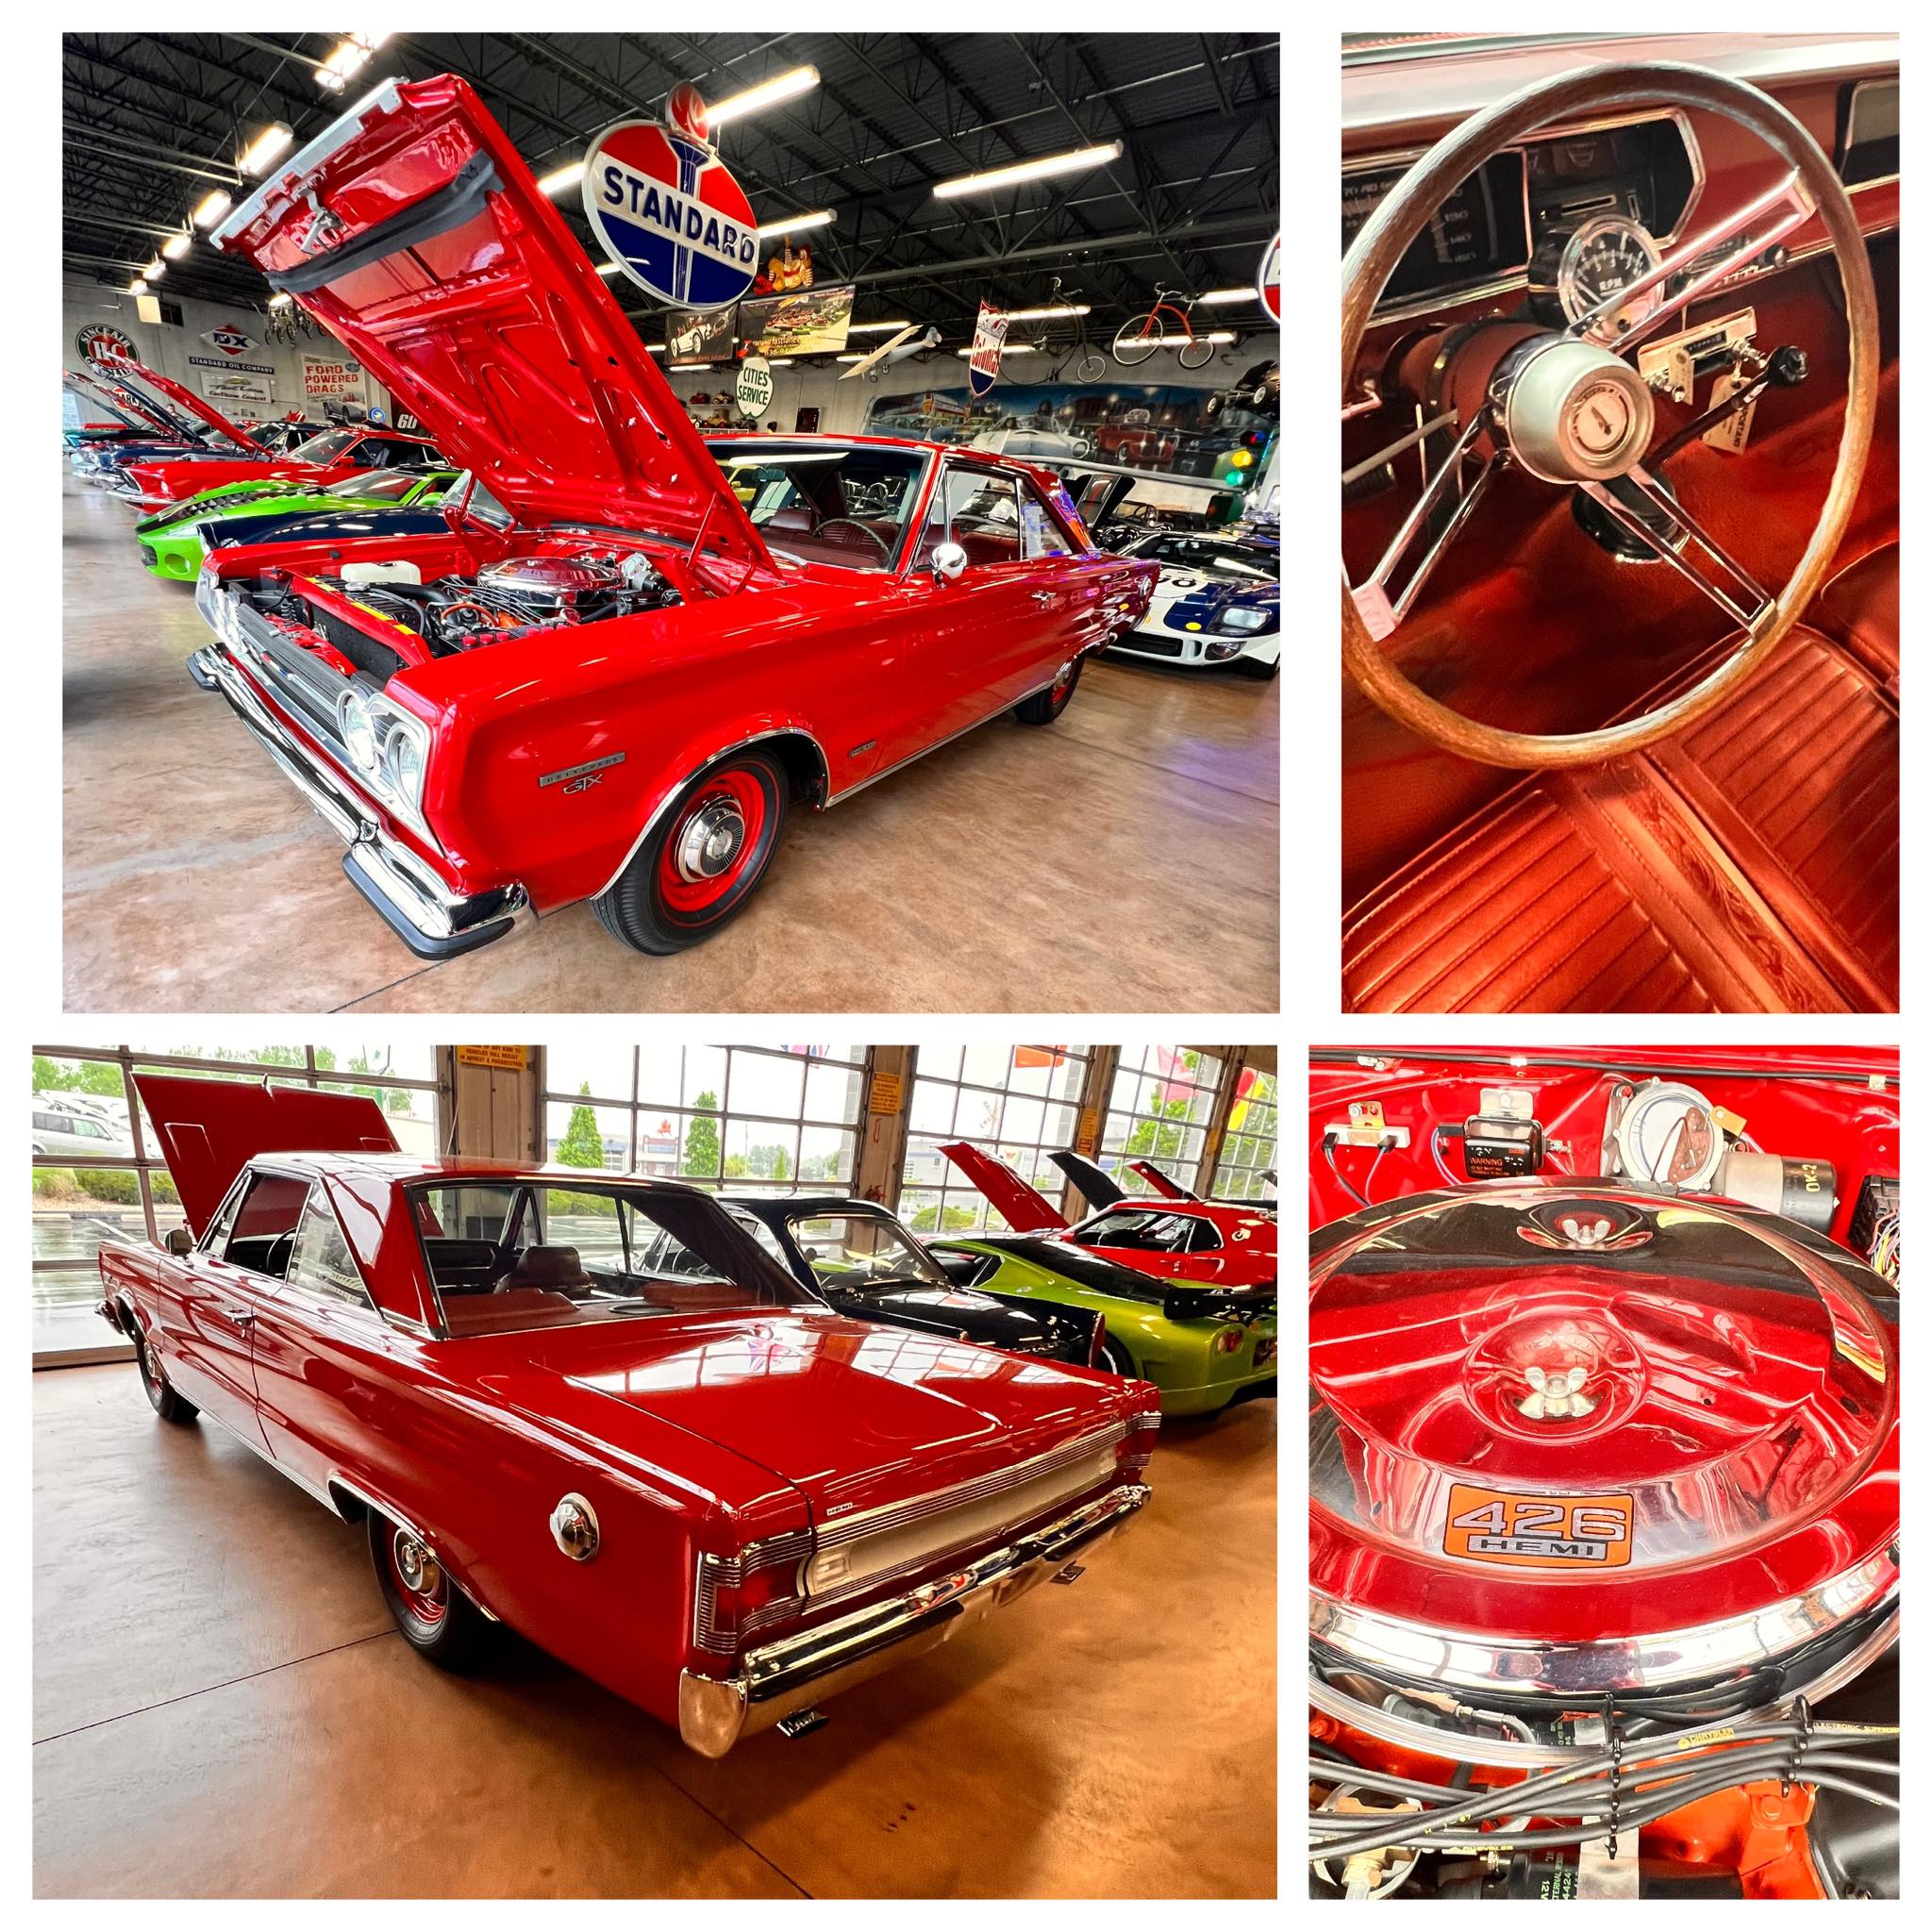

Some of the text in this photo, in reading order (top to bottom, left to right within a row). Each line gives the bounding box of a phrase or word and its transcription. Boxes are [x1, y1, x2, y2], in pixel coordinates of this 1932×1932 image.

[603, 165, 755, 264] STANDARD
[80, 326, 131, 348] SINCLAIR
[213, 332, 250, 348] DX
[191, 357, 227, 368] STANDARD
[242, 364, 274, 375] COMPANY
[306, 365, 343, 375] FORD
[305, 374, 358, 384] POWERED
[742, 366, 769, 388] CITIES
[306, 384, 344, 393] DRAGS
[737, 384, 770, 407] SERVICE
[563, 773, 605, 795] GTX
[1470, 1156, 1503, 1167] WARNING
[1453, 1501, 1627, 1542] 426
[1480, 1539, 1594, 1557] HEMI
[1690, 1726, 1736, 1744] CHRYSLER
